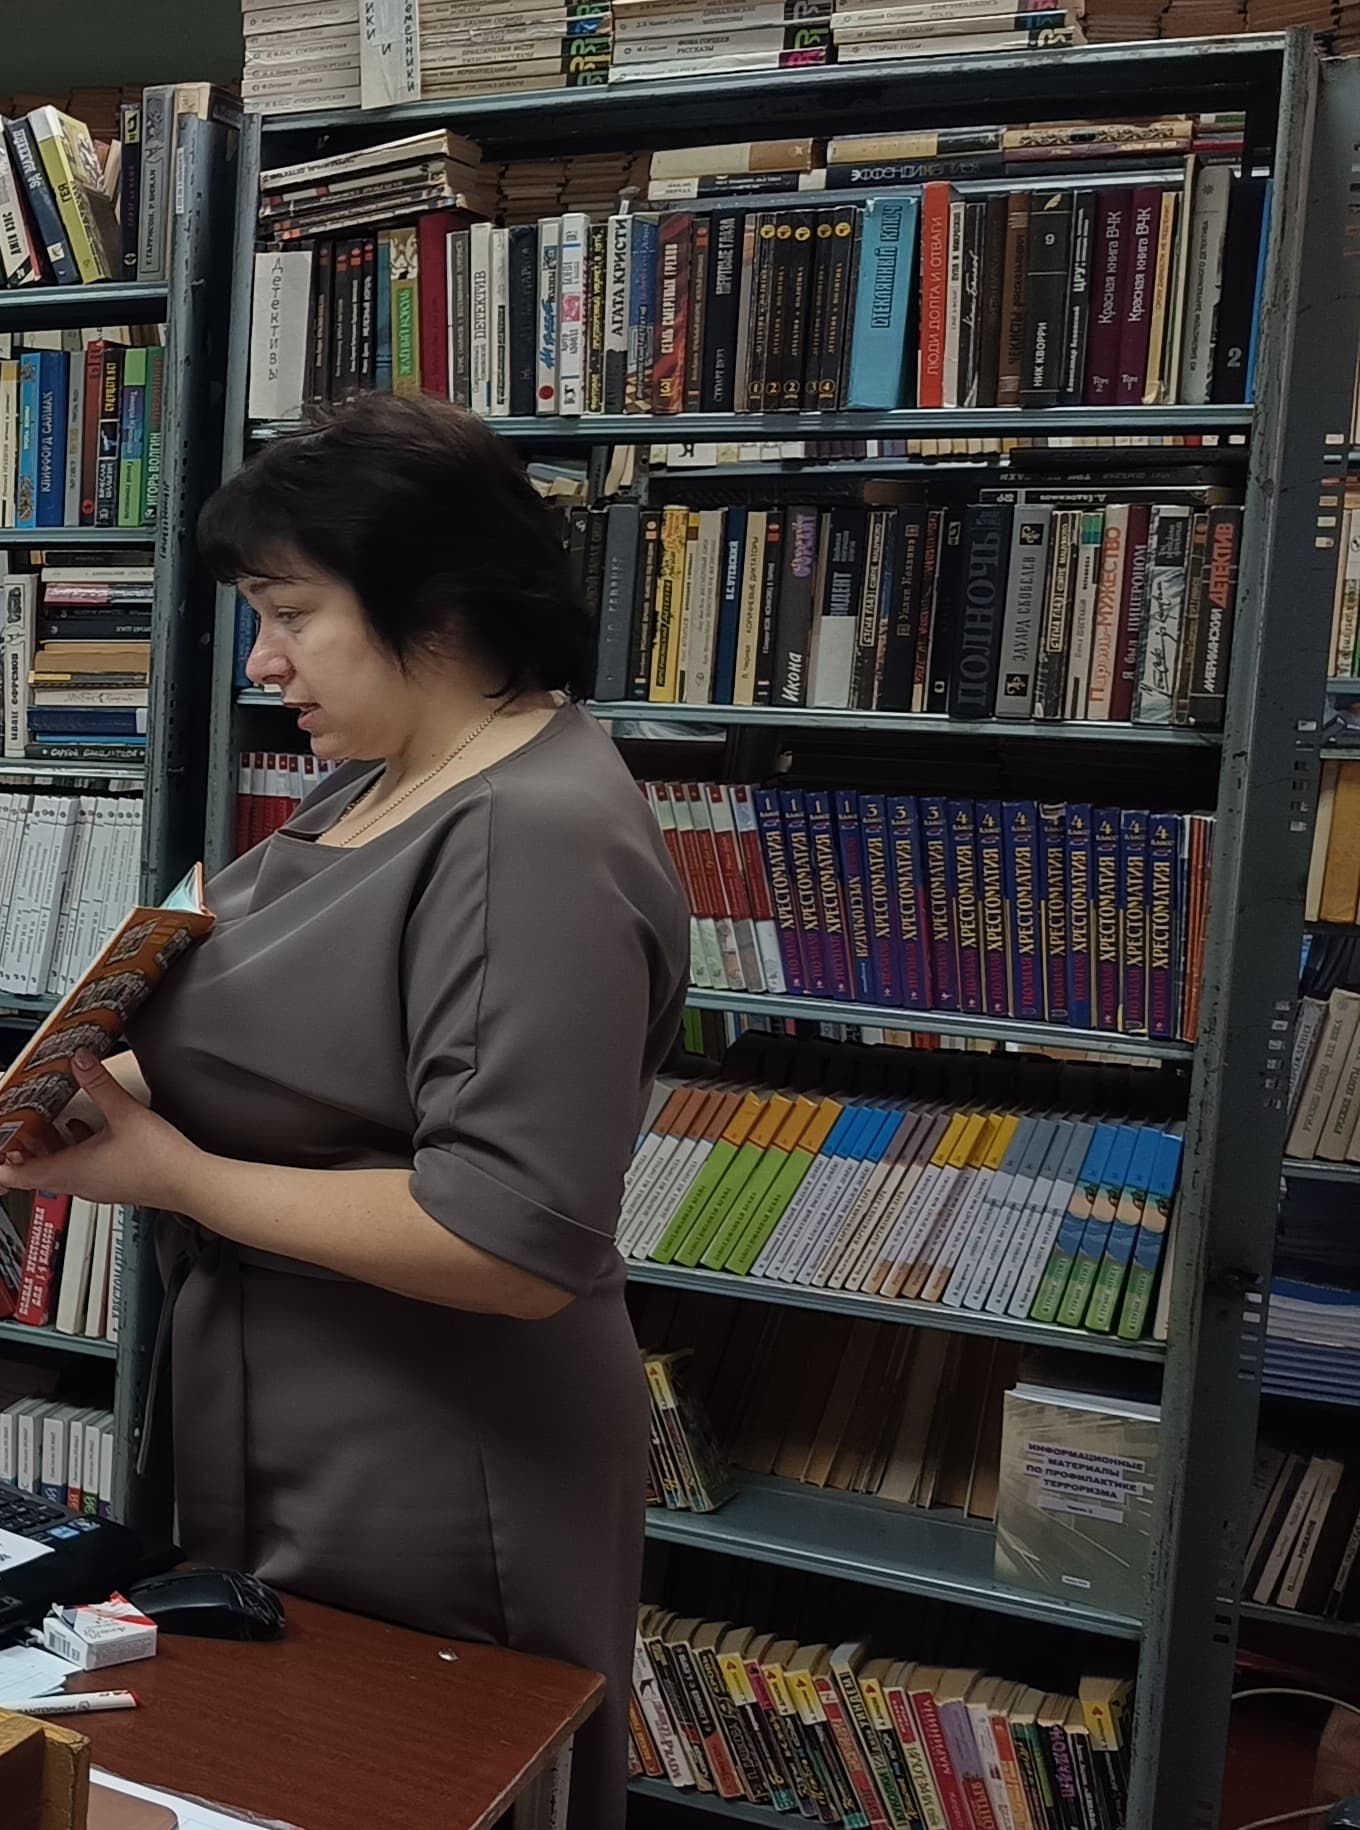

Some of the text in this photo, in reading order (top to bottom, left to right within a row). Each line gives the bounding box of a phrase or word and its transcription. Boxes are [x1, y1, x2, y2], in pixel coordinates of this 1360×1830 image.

[611, 219, 627, 336] АГАТА КРИСТИ
[932, 216, 943, 272] ОТВАГИ
[1098, 210, 1122, 325] Красная книга ВЧК
[1128, 207, 1152, 322] Красная книга ВЧК
[928, 331, 941, 376] ЛЮДИ
[929, 287, 942, 328] ДОЛГА
[1033, 322, 1047, 388] НИК КВОРРИ
[660, 380, 671, 395] 3
[1227, 347, 1242, 369] 2
[41, 437, 53, 493] КЛИФФОРД
[147, 433, 161, 507] ИГОРЬ ВОЛГИН
[749, 535, 759, 580] ДИКТАТОРЫ
[1204, 522, 1234, 693] АМЕРИКАНСКИЙ ДЕТЕКТИВ
[782, 651, 803, 703] Икона
[766, 830, 795, 930] ХРЕСТОМАТИЯ
[791, 832, 819, 931] ХРЕСТОМАТИЯ
[815, 834, 842, 934] ХРЕСТОМАТИЯ
[848, 875, 869, 958] ХРЕСТОМАТИЯ
[868, 837, 891, 938] ХРЕСТОМАТИЯ
[896, 840, 918, 941] ХРЕСТОМАТИЯ
[928, 840, 949, 942] ХРЕСТОМАТИЯ
[956, 845, 977, 949] ХРЕСТОМАТИЯ
[983, 848, 1004, 952] ХРЕСТОМАТИЯ
[1015, 847, 1035, 955] ХРЕСТОМАТИЯ
[1047, 847, 1066, 956] ХРЕСТОМАТИЯ
[1071, 851, 1088, 953] ХРЕСТОМАТИЯ
[1098, 856, 1117, 963] ХРЕСТОМАТИЯ
[1126, 856, 1144, 967] ХРЕСТОМАТИЯ
[1152, 861, 1170, 969] ХРЕСТОМАТИЯ
[1026, 1465, 1137, 1492] ПО ПРОФИЛАКТИКЕ
[1029, 1443, 1144, 1471] ИНФОРМАЦИОННЫЕ
[1043, 1479, 1117, 1499] ТЕРРОРИЗМА
[1048, 1458, 1120, 1477] МАТЕРИАЛЫ
